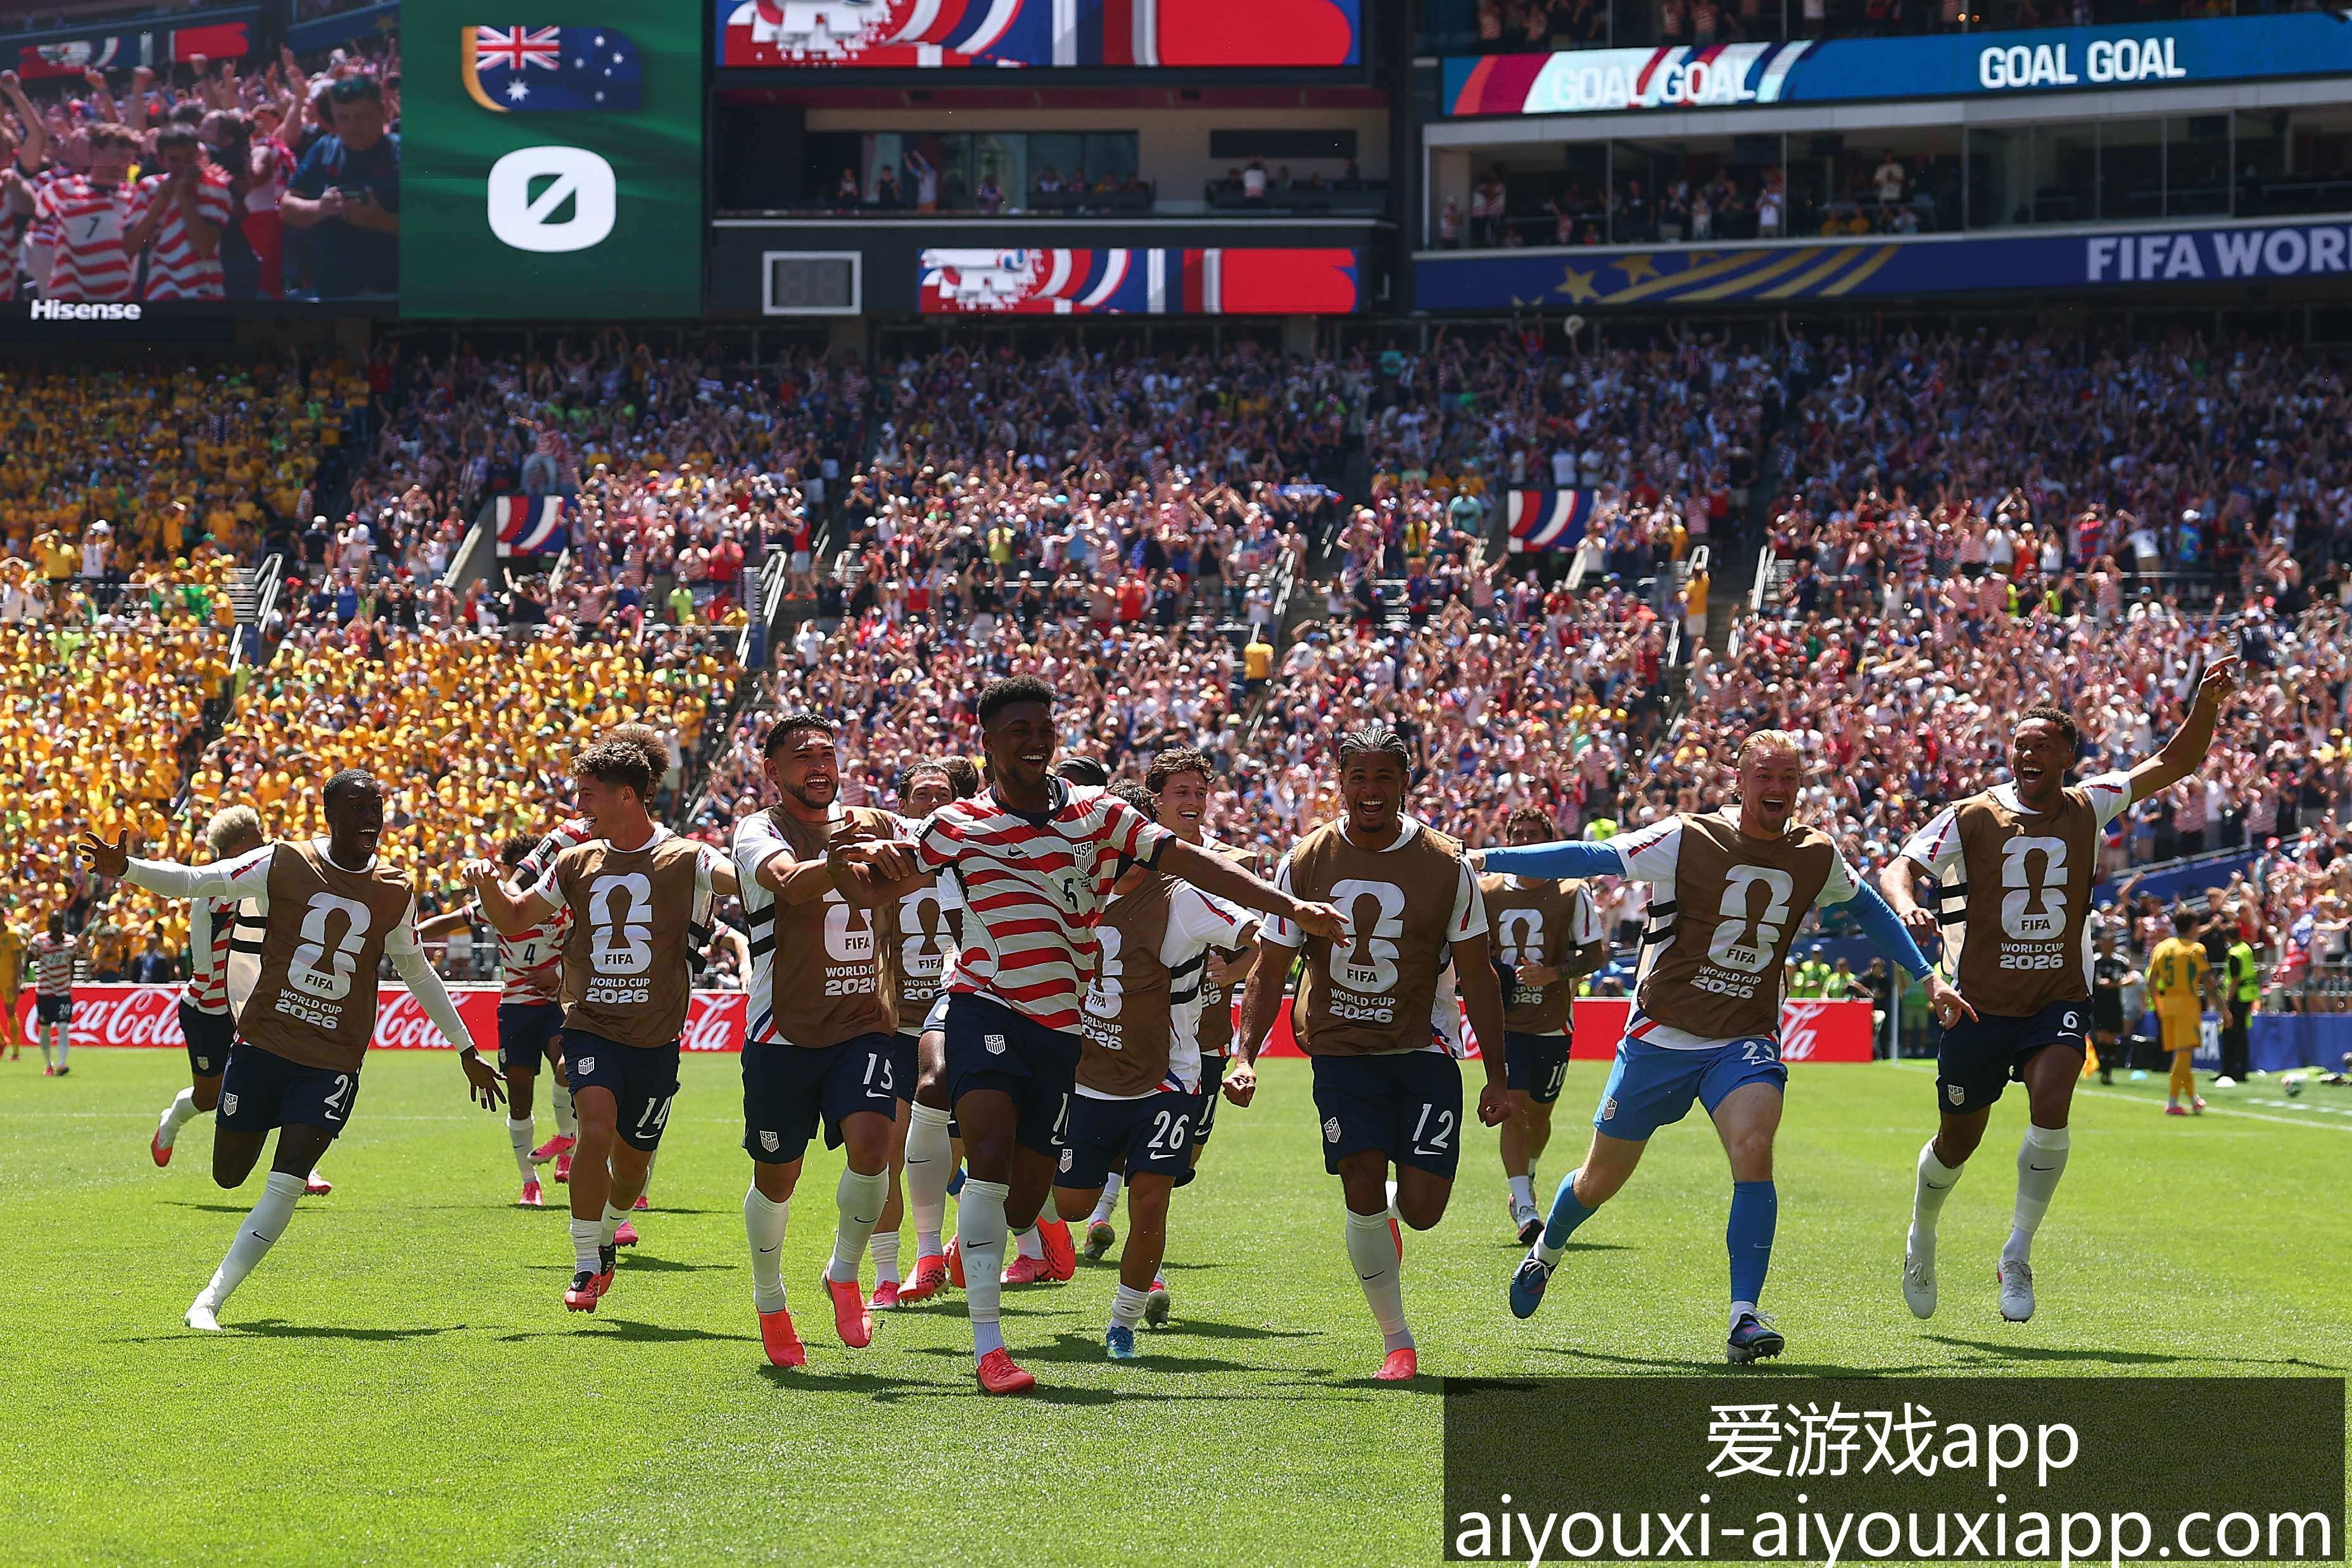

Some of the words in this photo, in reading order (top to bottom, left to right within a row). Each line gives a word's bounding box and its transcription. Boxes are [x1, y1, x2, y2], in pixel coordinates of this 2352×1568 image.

[1979, 43, 2078, 89] GOAL
[2087, 37, 2186, 82] GOAL
[1553, 63, 1647, 106] GOAL
[1660, 59, 1756, 103] GOAL
[488, 145, 616, 252] 0
[86, 216, 100, 239] 7
[2087, 234, 2205, 281] FIFA
[2213, 226, 2352, 276] WOR
[30, 299, 142, 320] Hisense
[1073, 842, 1092, 856] USA
[2021, 920, 2051, 931] FIFA
[845, 937, 871, 950] FIFA
[2001, 942, 2042, 952] WORLD
[2044, 942, 2064, 952] CUP
[524, 943, 536, 965] 4
[605, 953, 634, 964] FIFA
[1726, 948, 1756, 964] FIFA
[2000, 954, 2064, 970] 2026
[825, 966, 868, 977] WORLD
[1347, 968, 1378, 983] FIFA
[1698, 965, 1740, 982] WORLD
[305, 973, 334, 991] FIFA
[590, 977, 627, 987] WORLD
[629, 977, 650, 987] CUP
[1690, 975, 1754, 999] 2026
[280, 989, 320, 1008] WORLD
[320, 1003, 343, 1015] CUP
[585, 988, 649, 1004] 2026
[903, 988, 933, 1001] 20
[1330, 988, 1369, 1006] WORLD
[1371, 997, 1396, 1006] CUP
[1512, 993, 1543, 1005] 026
[275, 999, 338, 1029] 2026
[1329, 1000, 1394, 1023] 2026
[2063, 1011, 2080, 1028] 6
[1082, 1013, 1103, 1029] ORLD
[1103, 1022, 1123, 1034] CUP
[985, 1035, 1003, 1044] USA
[1082, 1024, 1123, 1051] 026
[579, 1058, 593, 1066] USA
[863, 1053, 893, 1089] 15
[225, 1093, 237, 1104] USA
[324, 1074, 353, 1113] 21
[1949, 1086, 1963, 1094] USA
[636, 1096, 671, 1130] 14
[1148, 1110, 1189, 1149] 26
[1324, 1118, 1337, 1131] USA
[1412, 1104, 1453, 1148] 12
[761, 1131, 776, 1141] USA
